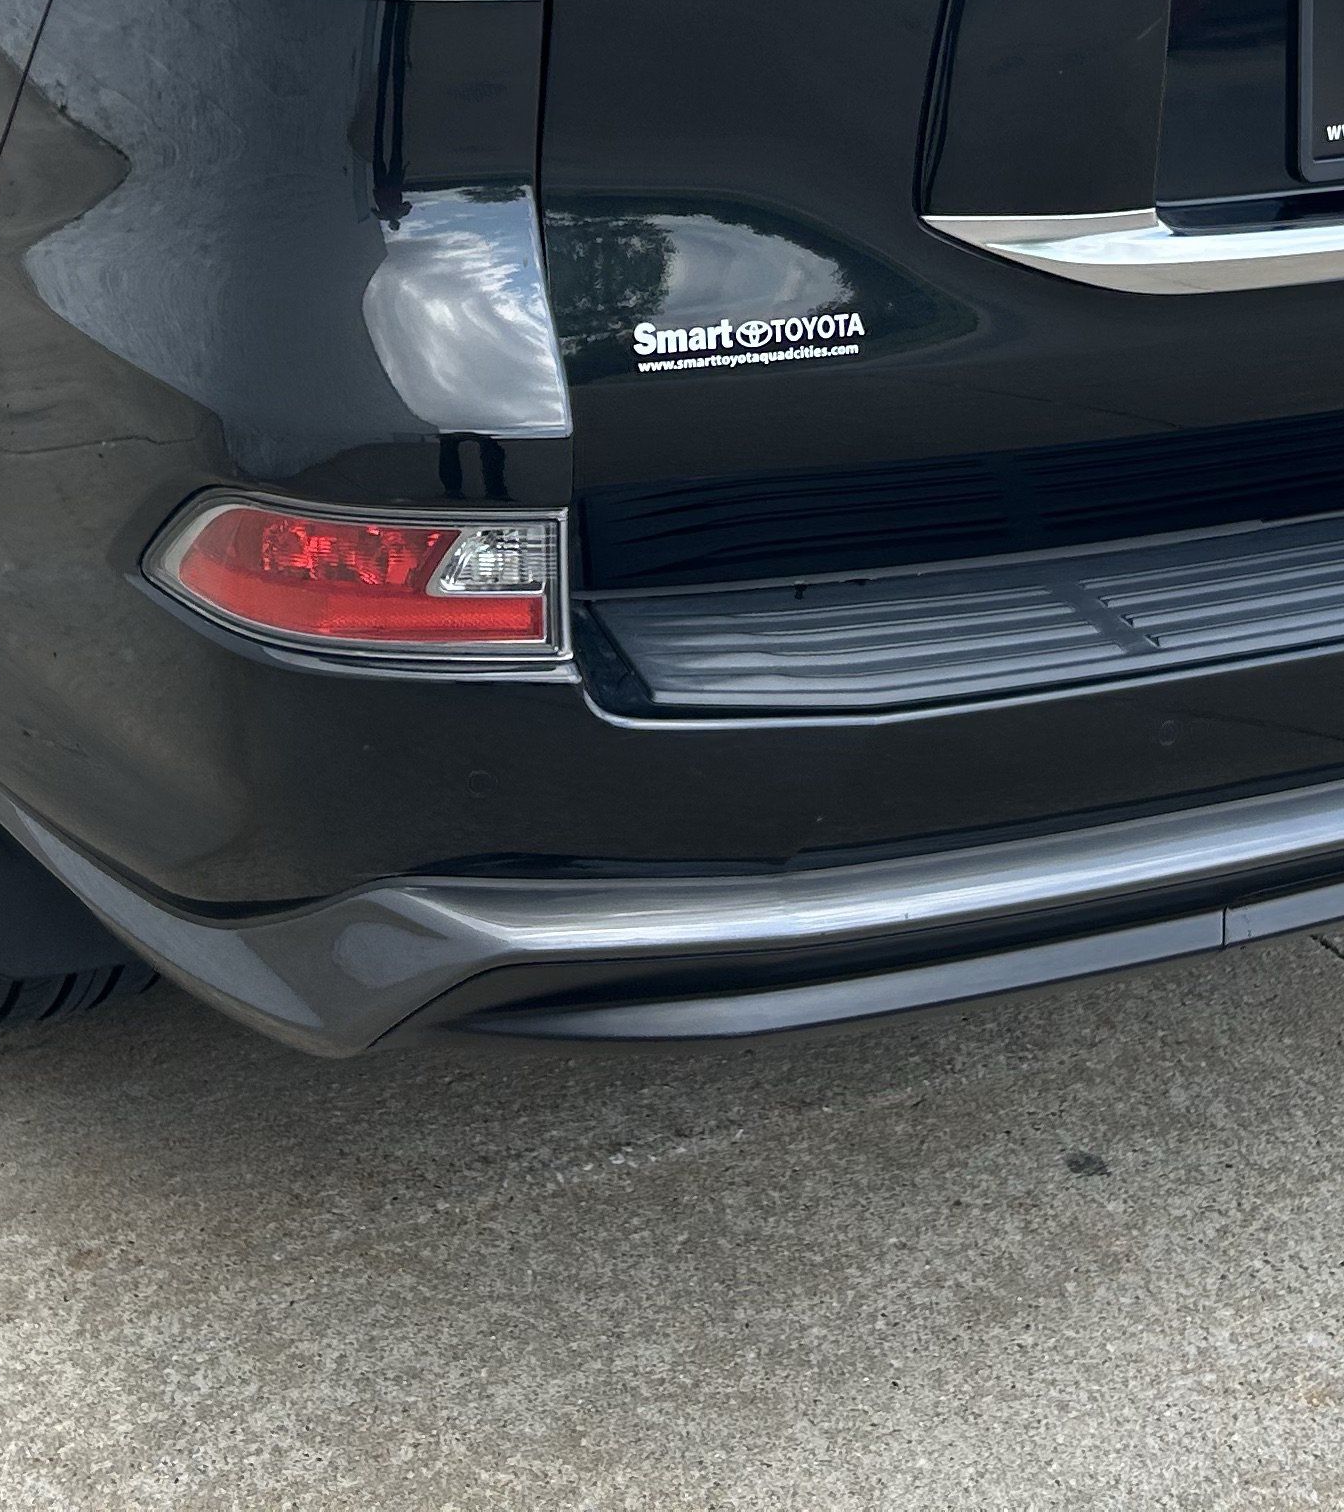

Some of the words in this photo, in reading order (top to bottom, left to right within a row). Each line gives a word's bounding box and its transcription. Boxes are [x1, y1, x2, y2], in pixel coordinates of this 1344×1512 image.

[633, 318, 734, 355] Smart
[769, 312, 866, 343] TOYOTA
[637, 343, 859, 372] www.smarttoyotaquadcities.com
